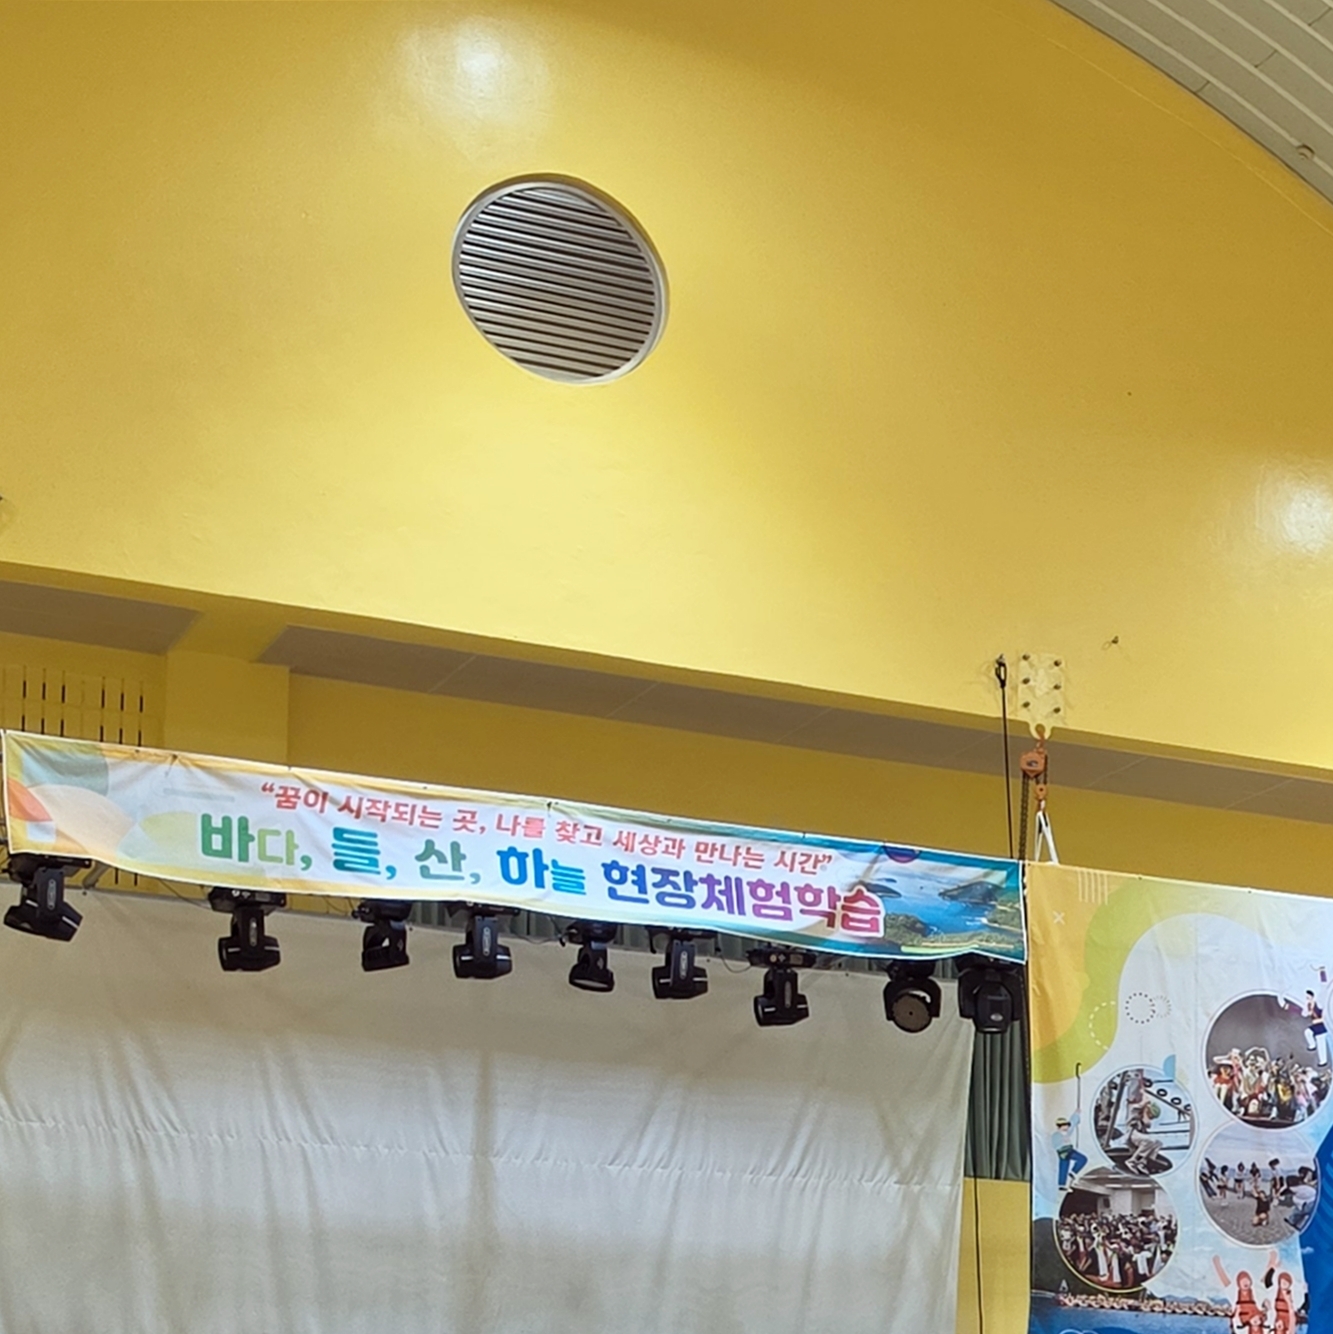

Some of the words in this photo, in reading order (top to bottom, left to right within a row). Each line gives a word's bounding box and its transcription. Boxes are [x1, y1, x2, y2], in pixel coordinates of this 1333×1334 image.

[201, 813, 312, 871] 바다,
[332, 826, 396, 880] 들,
[415, 838, 481, 884] 산,
[496, 846, 587, 895] 하늘
[601, 859, 882, 933] 현장체험학습
[261, 782, 328, 813] “꿈이
[337, 796, 443, 828] 시작되는
[452, 808, 486, 834] 곳,
[496, 813, 546, 839] 나를
[555, 820, 602, 847] 찾고
[612, 830, 686, 860] 세상과
[694, 840, 765, 870] 만나는
[774, 850, 832, 875] 시간”
